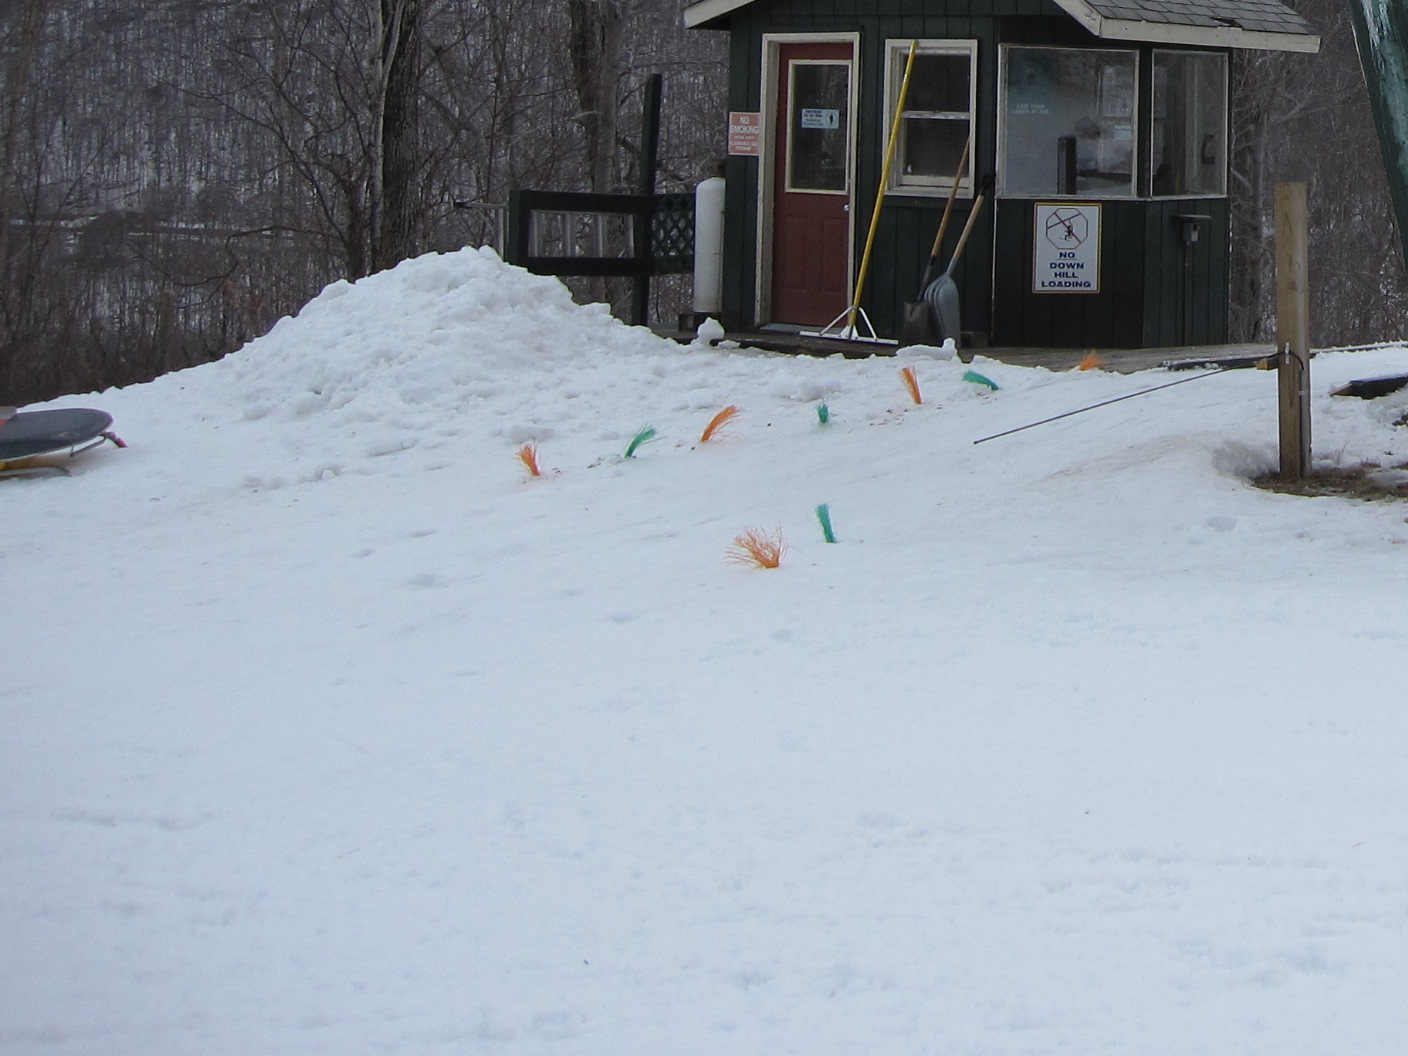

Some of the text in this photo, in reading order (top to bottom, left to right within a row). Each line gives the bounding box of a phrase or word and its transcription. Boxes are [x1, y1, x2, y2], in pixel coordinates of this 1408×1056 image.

[739, 116, 750, 124] NO
[729, 125, 760, 134] SMOKING
[1059, 251, 1076, 259] NO
[1041, 280, 1091, 288] LOADING
